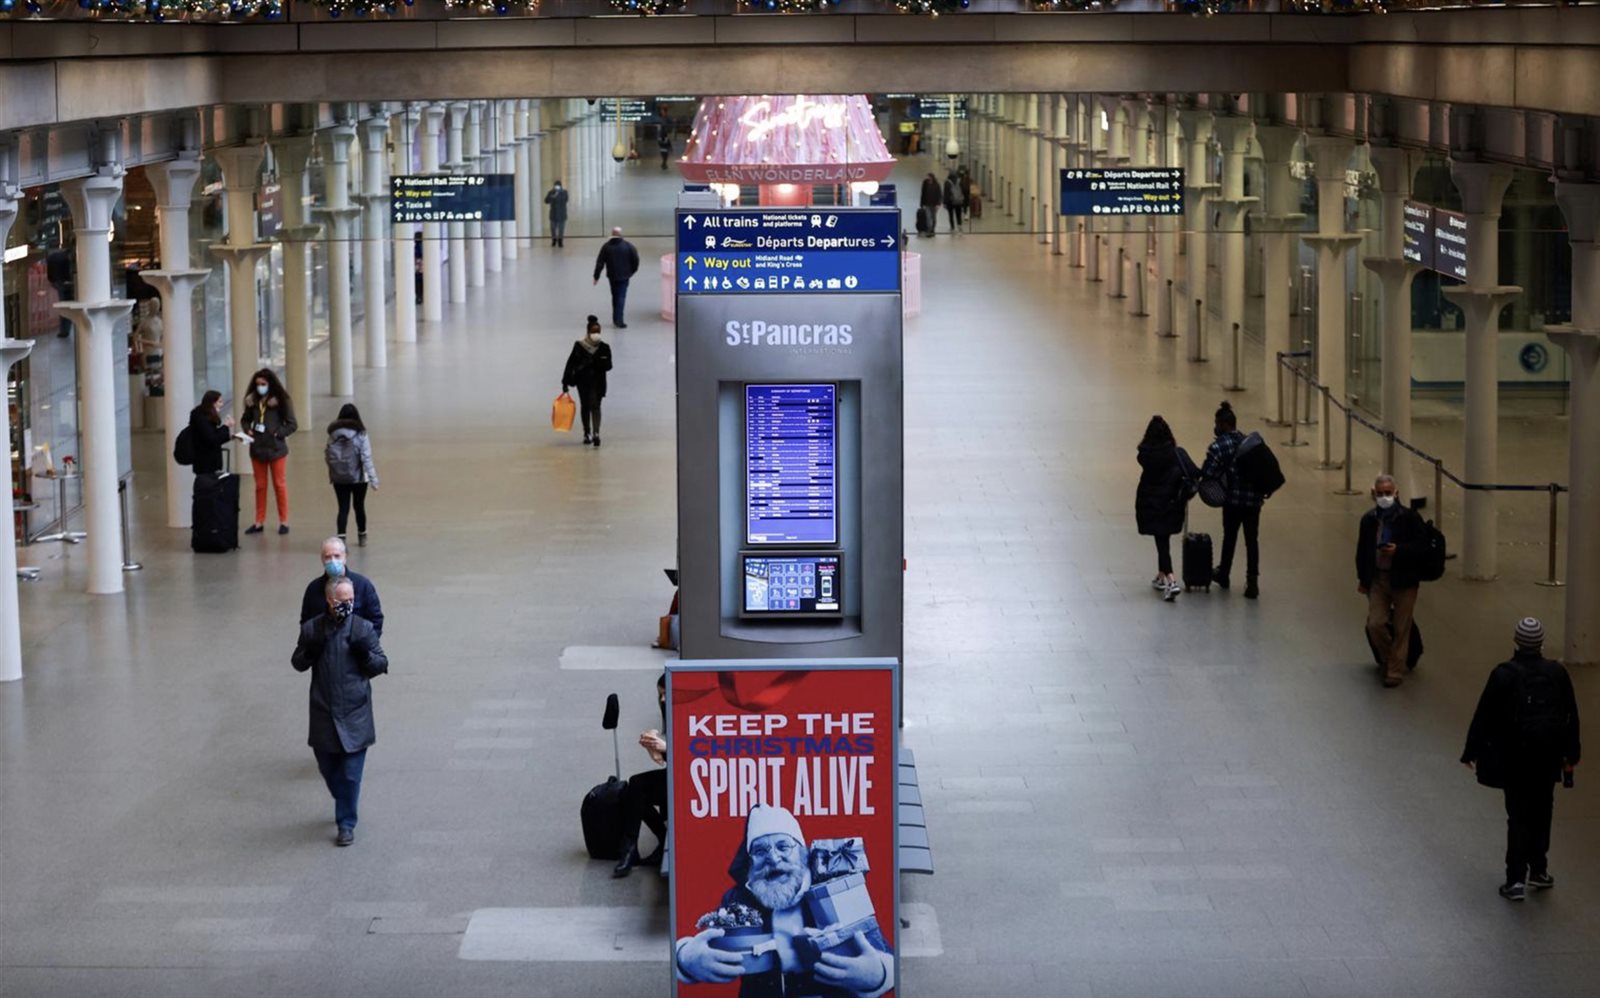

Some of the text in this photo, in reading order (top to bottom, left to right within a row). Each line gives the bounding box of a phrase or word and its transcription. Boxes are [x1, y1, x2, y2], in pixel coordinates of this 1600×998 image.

[748, 167, 866, 181] WONDERLAND
[1104, 170, 1131, 180] Départs
[1131, 170, 1170, 180] Departures
[404, 177, 433, 186] National
[433, 177, 448, 186] Rail
[1126, 182, 1155, 190] National
[1155, 181, 1170, 190] Rail
[405, 190, 420, 198] Way
[1142, 194, 1158, 202] Way
[703, 216, 759, 228] All trains
[756, 236, 805, 250] Départs
[807, 236, 876, 250] Departures
[703, 257, 752, 271] Way out
[755, 261, 766, 269] and
[766, 261, 785, 269] King's
[688, 713, 875, 736] KEEP THE
[688, 735, 875, 757] CHRISTMAS
[689, 755, 876, 818] SPIRIT ALIVE
